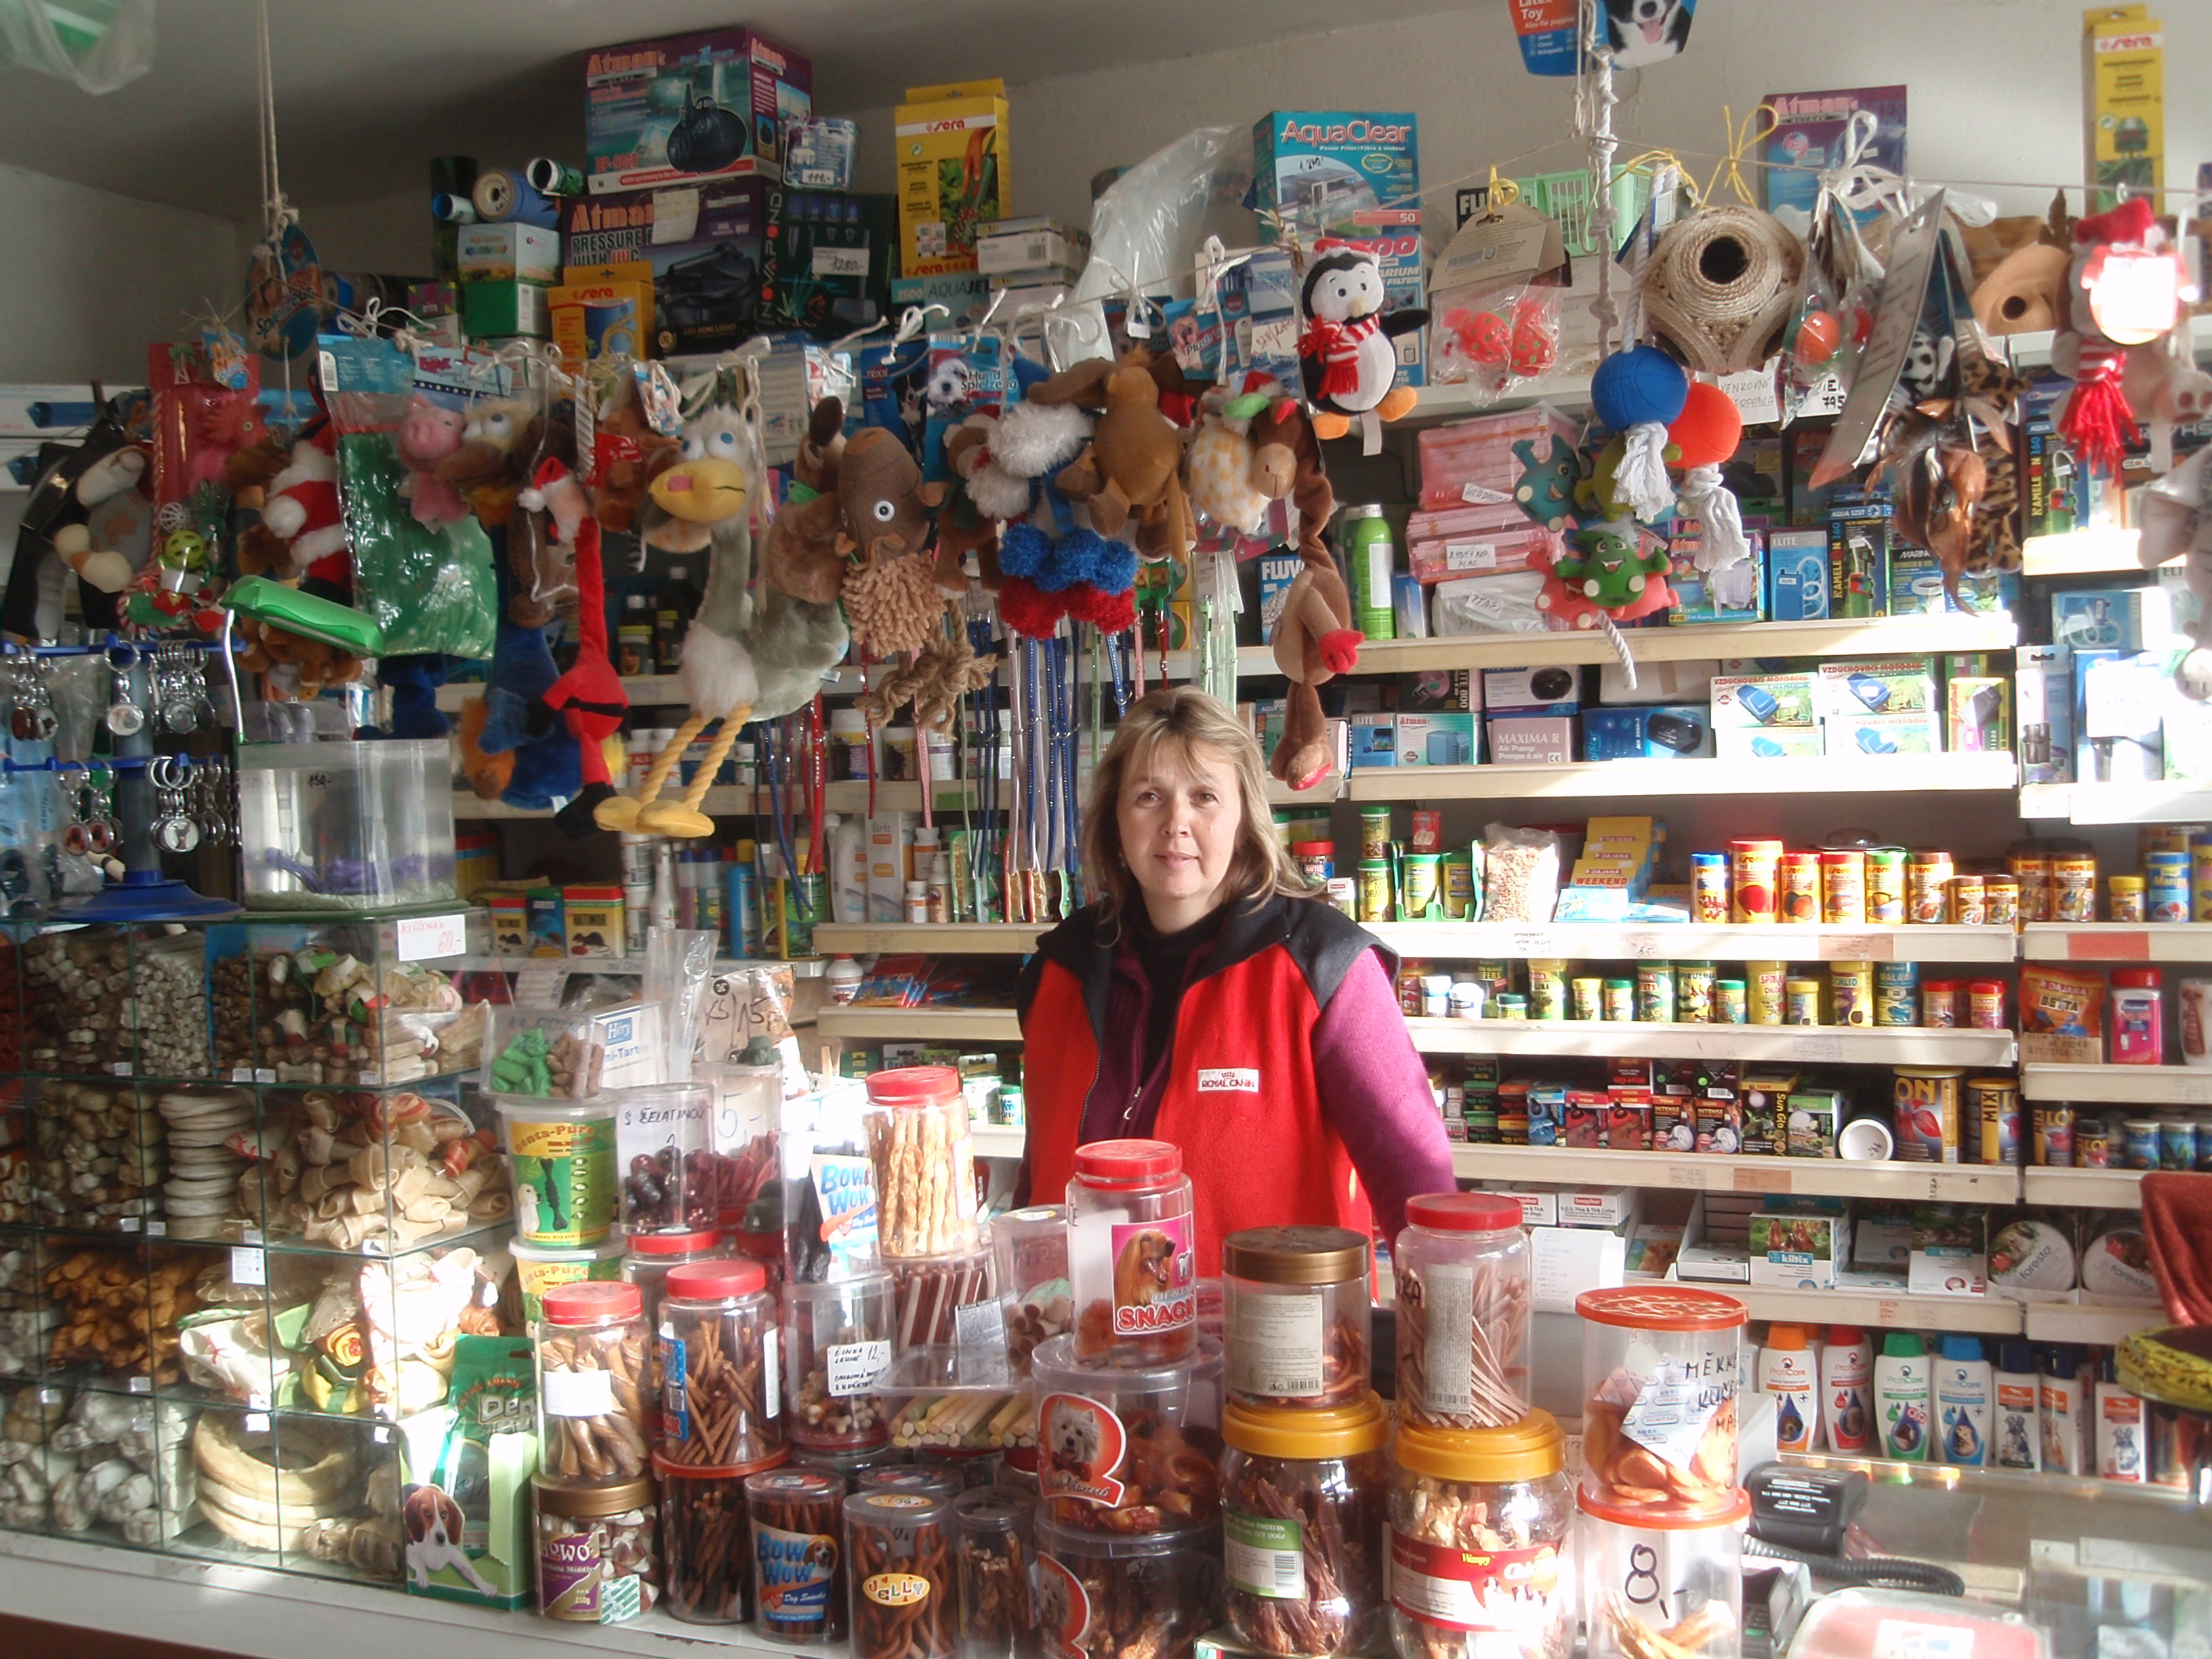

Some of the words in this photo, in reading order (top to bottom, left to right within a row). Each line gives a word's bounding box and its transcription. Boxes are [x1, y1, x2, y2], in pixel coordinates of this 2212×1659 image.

[1520, 8, 1542, 22] Toy
[2111, 35, 2152, 49] sera
[935, 119, 965, 131] sera
[1282, 120, 1411, 148] AquaClear
[1460, 192, 1490, 214] FLU
[1399, 213, 1416, 224] 50
[571, 228, 642, 252] PRESSURE
[1369, 236, 1418, 258] 00
[571, 249, 607, 266] WITH
[1378, 267, 1420, 276] ARIUM
[579, 286, 614, 301] sera
[1186, 333, 1214, 356] Plush
[1736, 394, 1774, 409] ERPADLA
[1773, 537, 1797, 546] ELITE
[1261, 560, 1305, 581] FLUV
[1460, 689, 1469, 708] 800
[1497, 733, 1548, 744] MAXIMA
[1551, 732, 1560, 744] R
[1498, 744, 1510, 752] Air
[1512, 745, 1536, 754] Pump
[1497, 752, 1521, 762] Pompe
[872, 823, 890, 833] Brit
[1576, 876, 1628, 885] WEEKEND
[1478, 971, 1500, 979] FERS
[1680, 971, 1717, 980] PIRULINA
[2048, 982, 2087, 996] DAJANA
[2040, 995, 2080, 1012] BETTA
[1201, 1079, 1228, 1088] ROYAL
[1776, 1093, 1786, 1111] Sun
[1982, 1092, 1999, 1123] MIX
[1776, 1113, 1786, 1129] Glo
[1781, 1253, 1808, 1263] kiltix
[2019, 1244, 2053, 1279] foresto
[1769, 1367, 1805, 1376] ProfiCare
[478, 1393, 536, 1422] Den
[1256, 1523, 1285, 1532] PROTEIN
[783, 1593, 799, 1604] Dog
